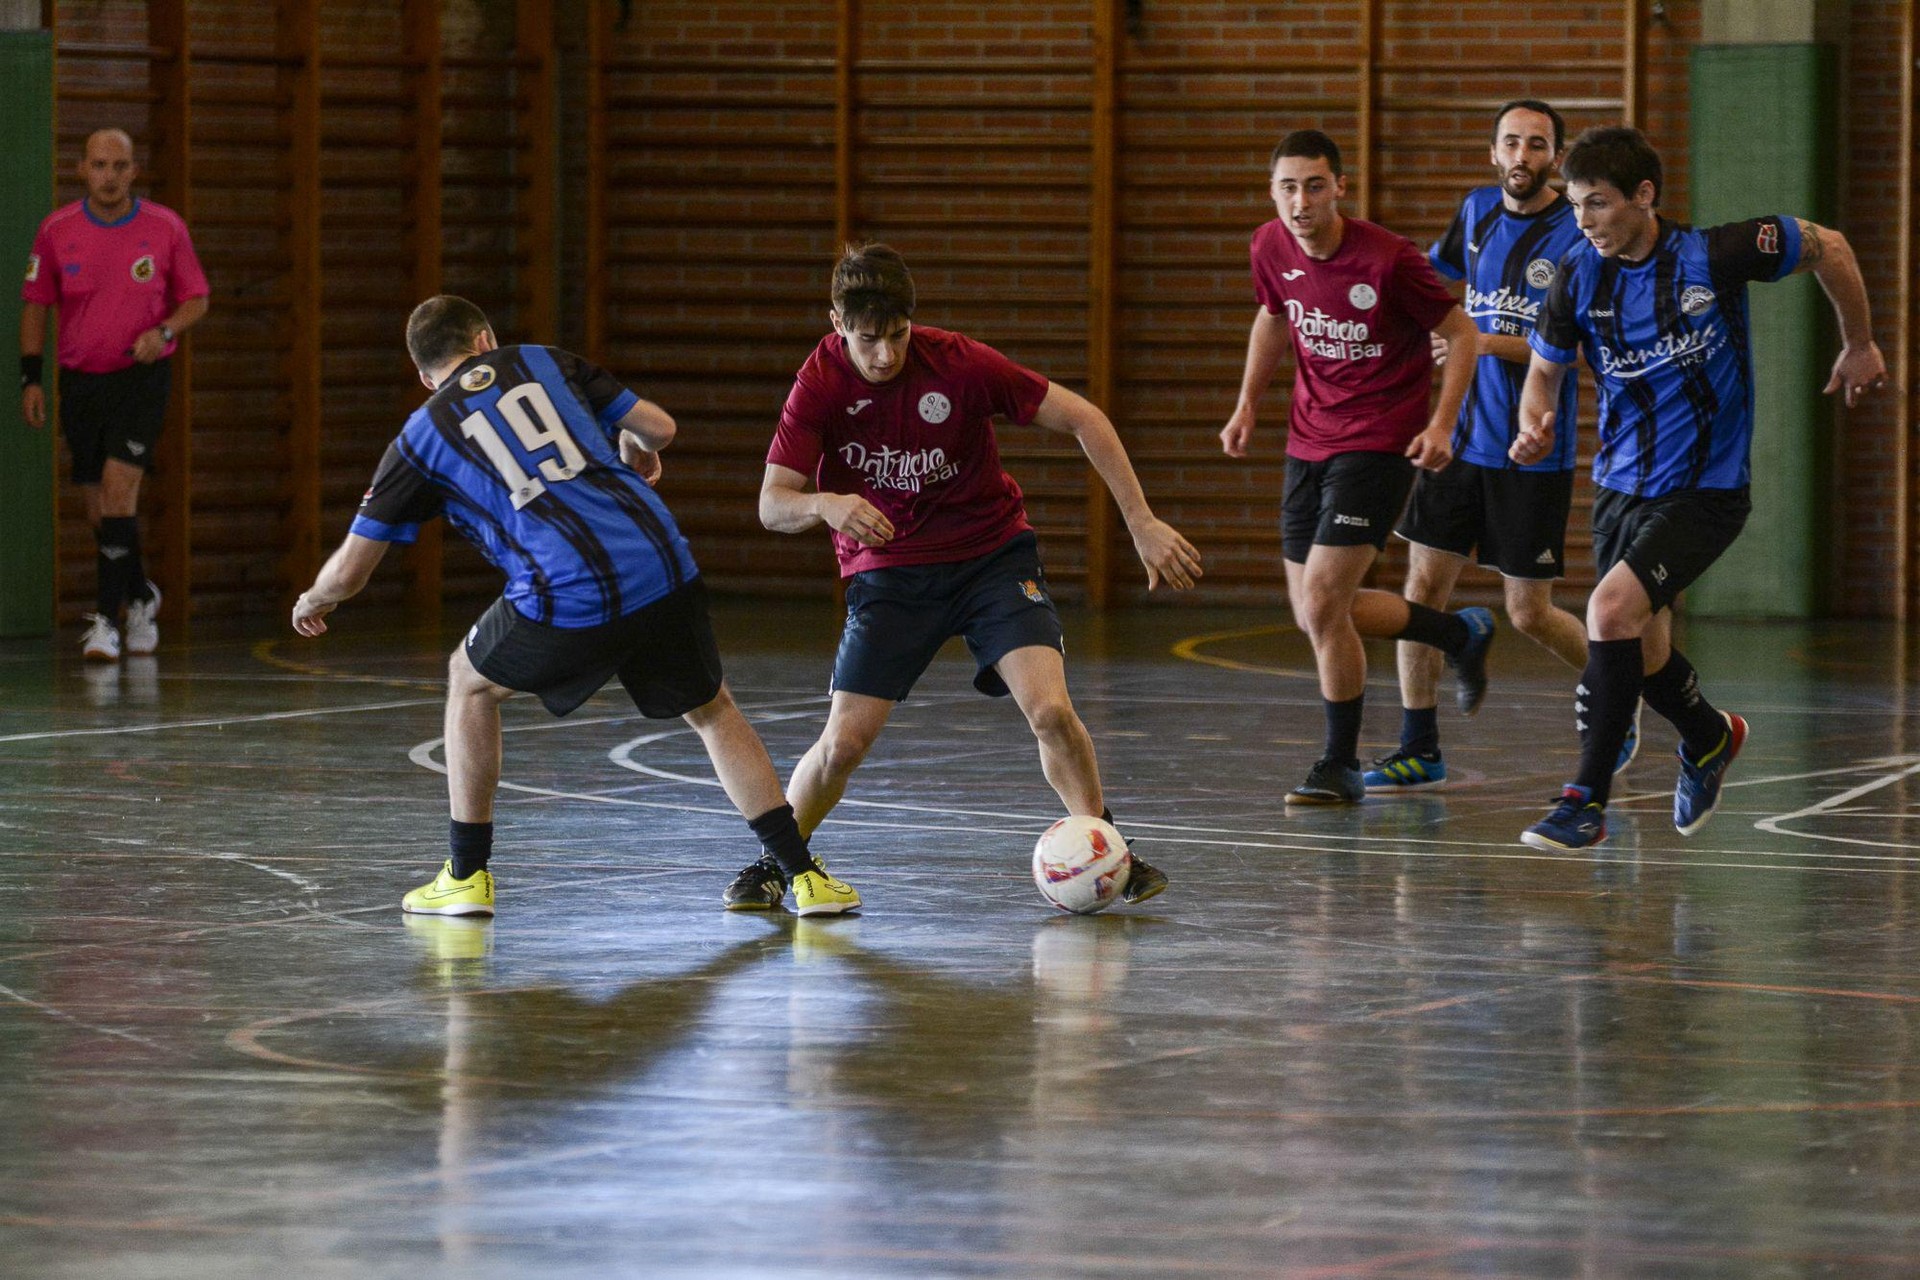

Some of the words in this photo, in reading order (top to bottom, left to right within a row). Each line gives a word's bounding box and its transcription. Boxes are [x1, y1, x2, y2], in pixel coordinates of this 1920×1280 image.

[1491, 319, 1520, 336] CAFE
[1348, 344, 1385, 361] Bar
[459, 382, 588, 512] 19
